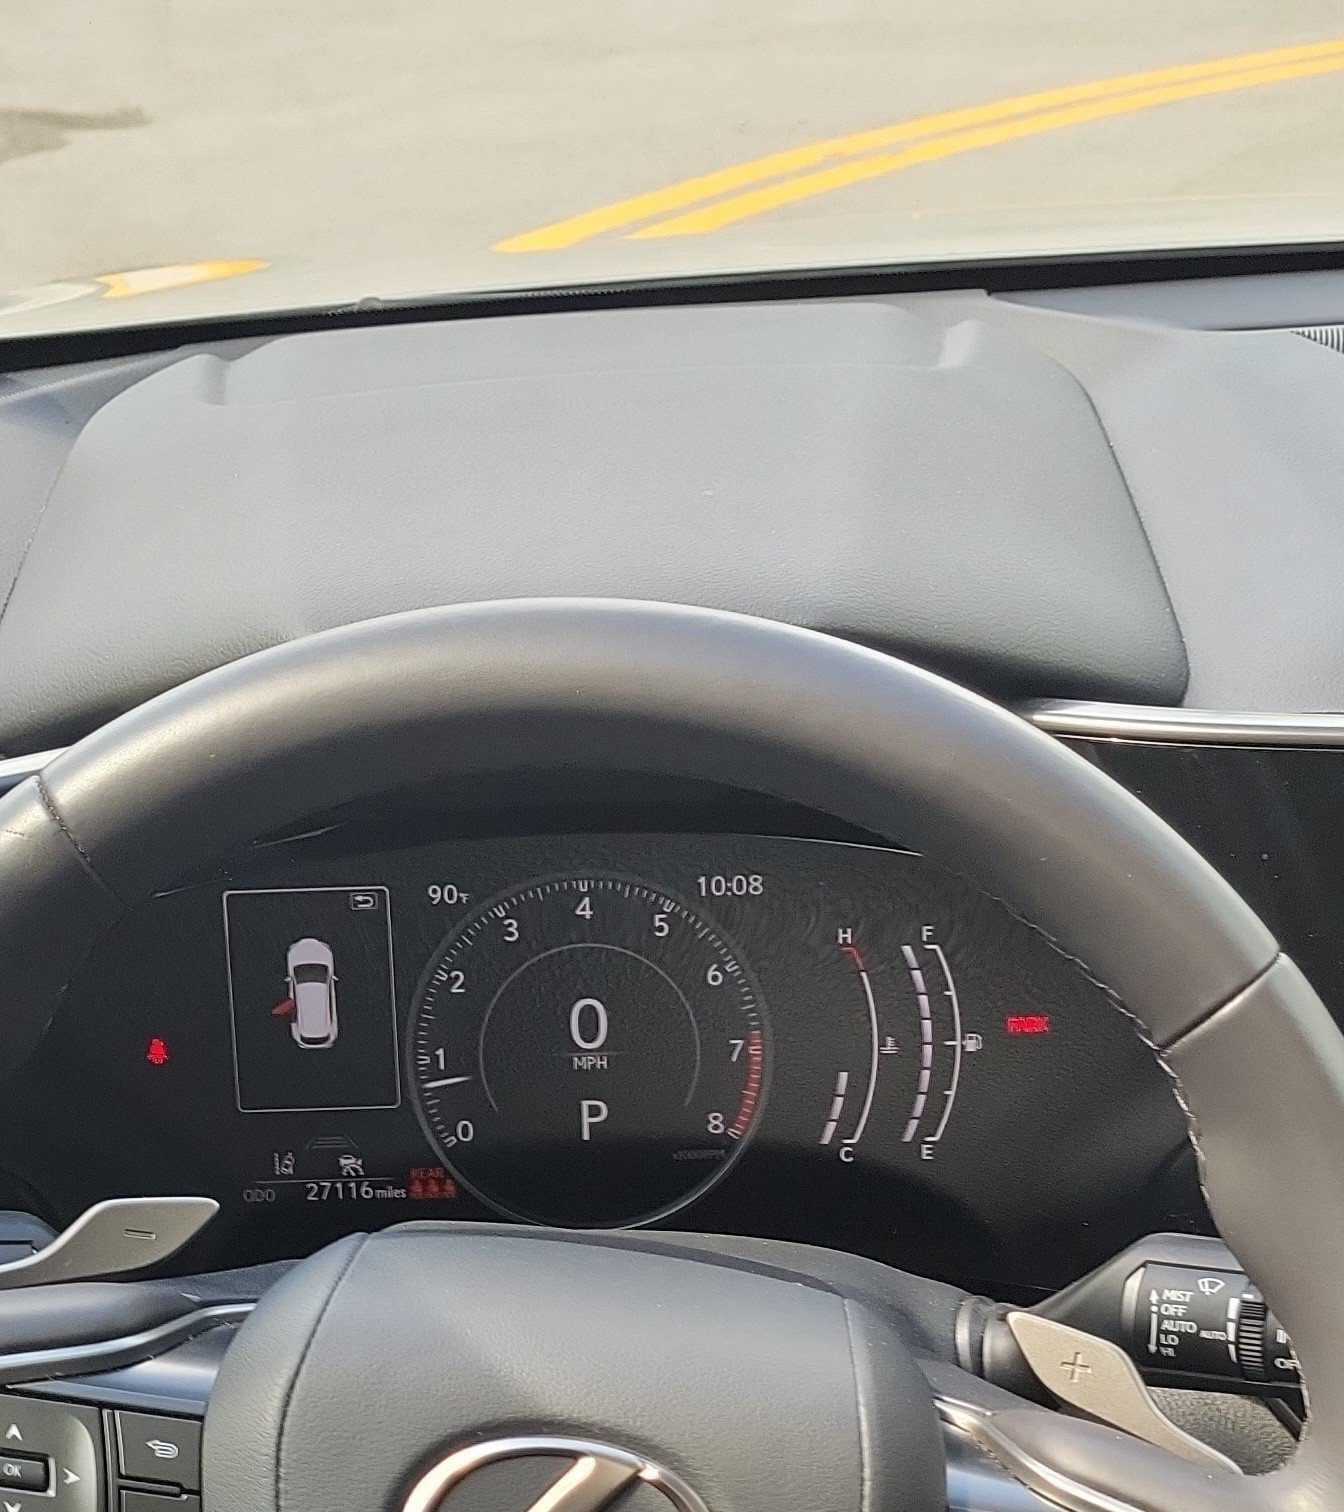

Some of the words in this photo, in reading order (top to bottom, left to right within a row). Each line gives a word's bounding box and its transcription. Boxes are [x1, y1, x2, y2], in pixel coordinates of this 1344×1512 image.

[696, 875, 764, 897] 10:08
[575, 897, 593, 919] 4
[503, 919, 519, 941] 3
[654, 914, 669, 937] 5
[837, 928, 852, 945] H
[921, 926, 934, 942] F
[450, 970, 466, 993] 2
[707, 964, 723, 986] 6
[569, 998, 608, 1050] 0
[434, 1048, 446, 1070] 1
[729, 1039, 745, 1062] 7
[572, 1056, 608, 1070] MPH
[456, 1120, 474, 1142] 0
[580, 1100, 608, 1141] P
[707, 1112, 725, 1135] 8
[839, 1146, 854, 1162] C
[921, 1144, 934, 1160] E
[243, 1189, 275, 1203] ODO
[305, 1181, 374, 1201] 27116
[375, 1185, 407, 1199] miles
[1162, 1289, 1194, 1303] MIST
[1160, 1303, 1188, 1317] OFF
[1160, 1319, 1198, 1333] AUTO
[1160, 1333, 1179, 1345] LO
[2, 1463, 22, 1478] OK
